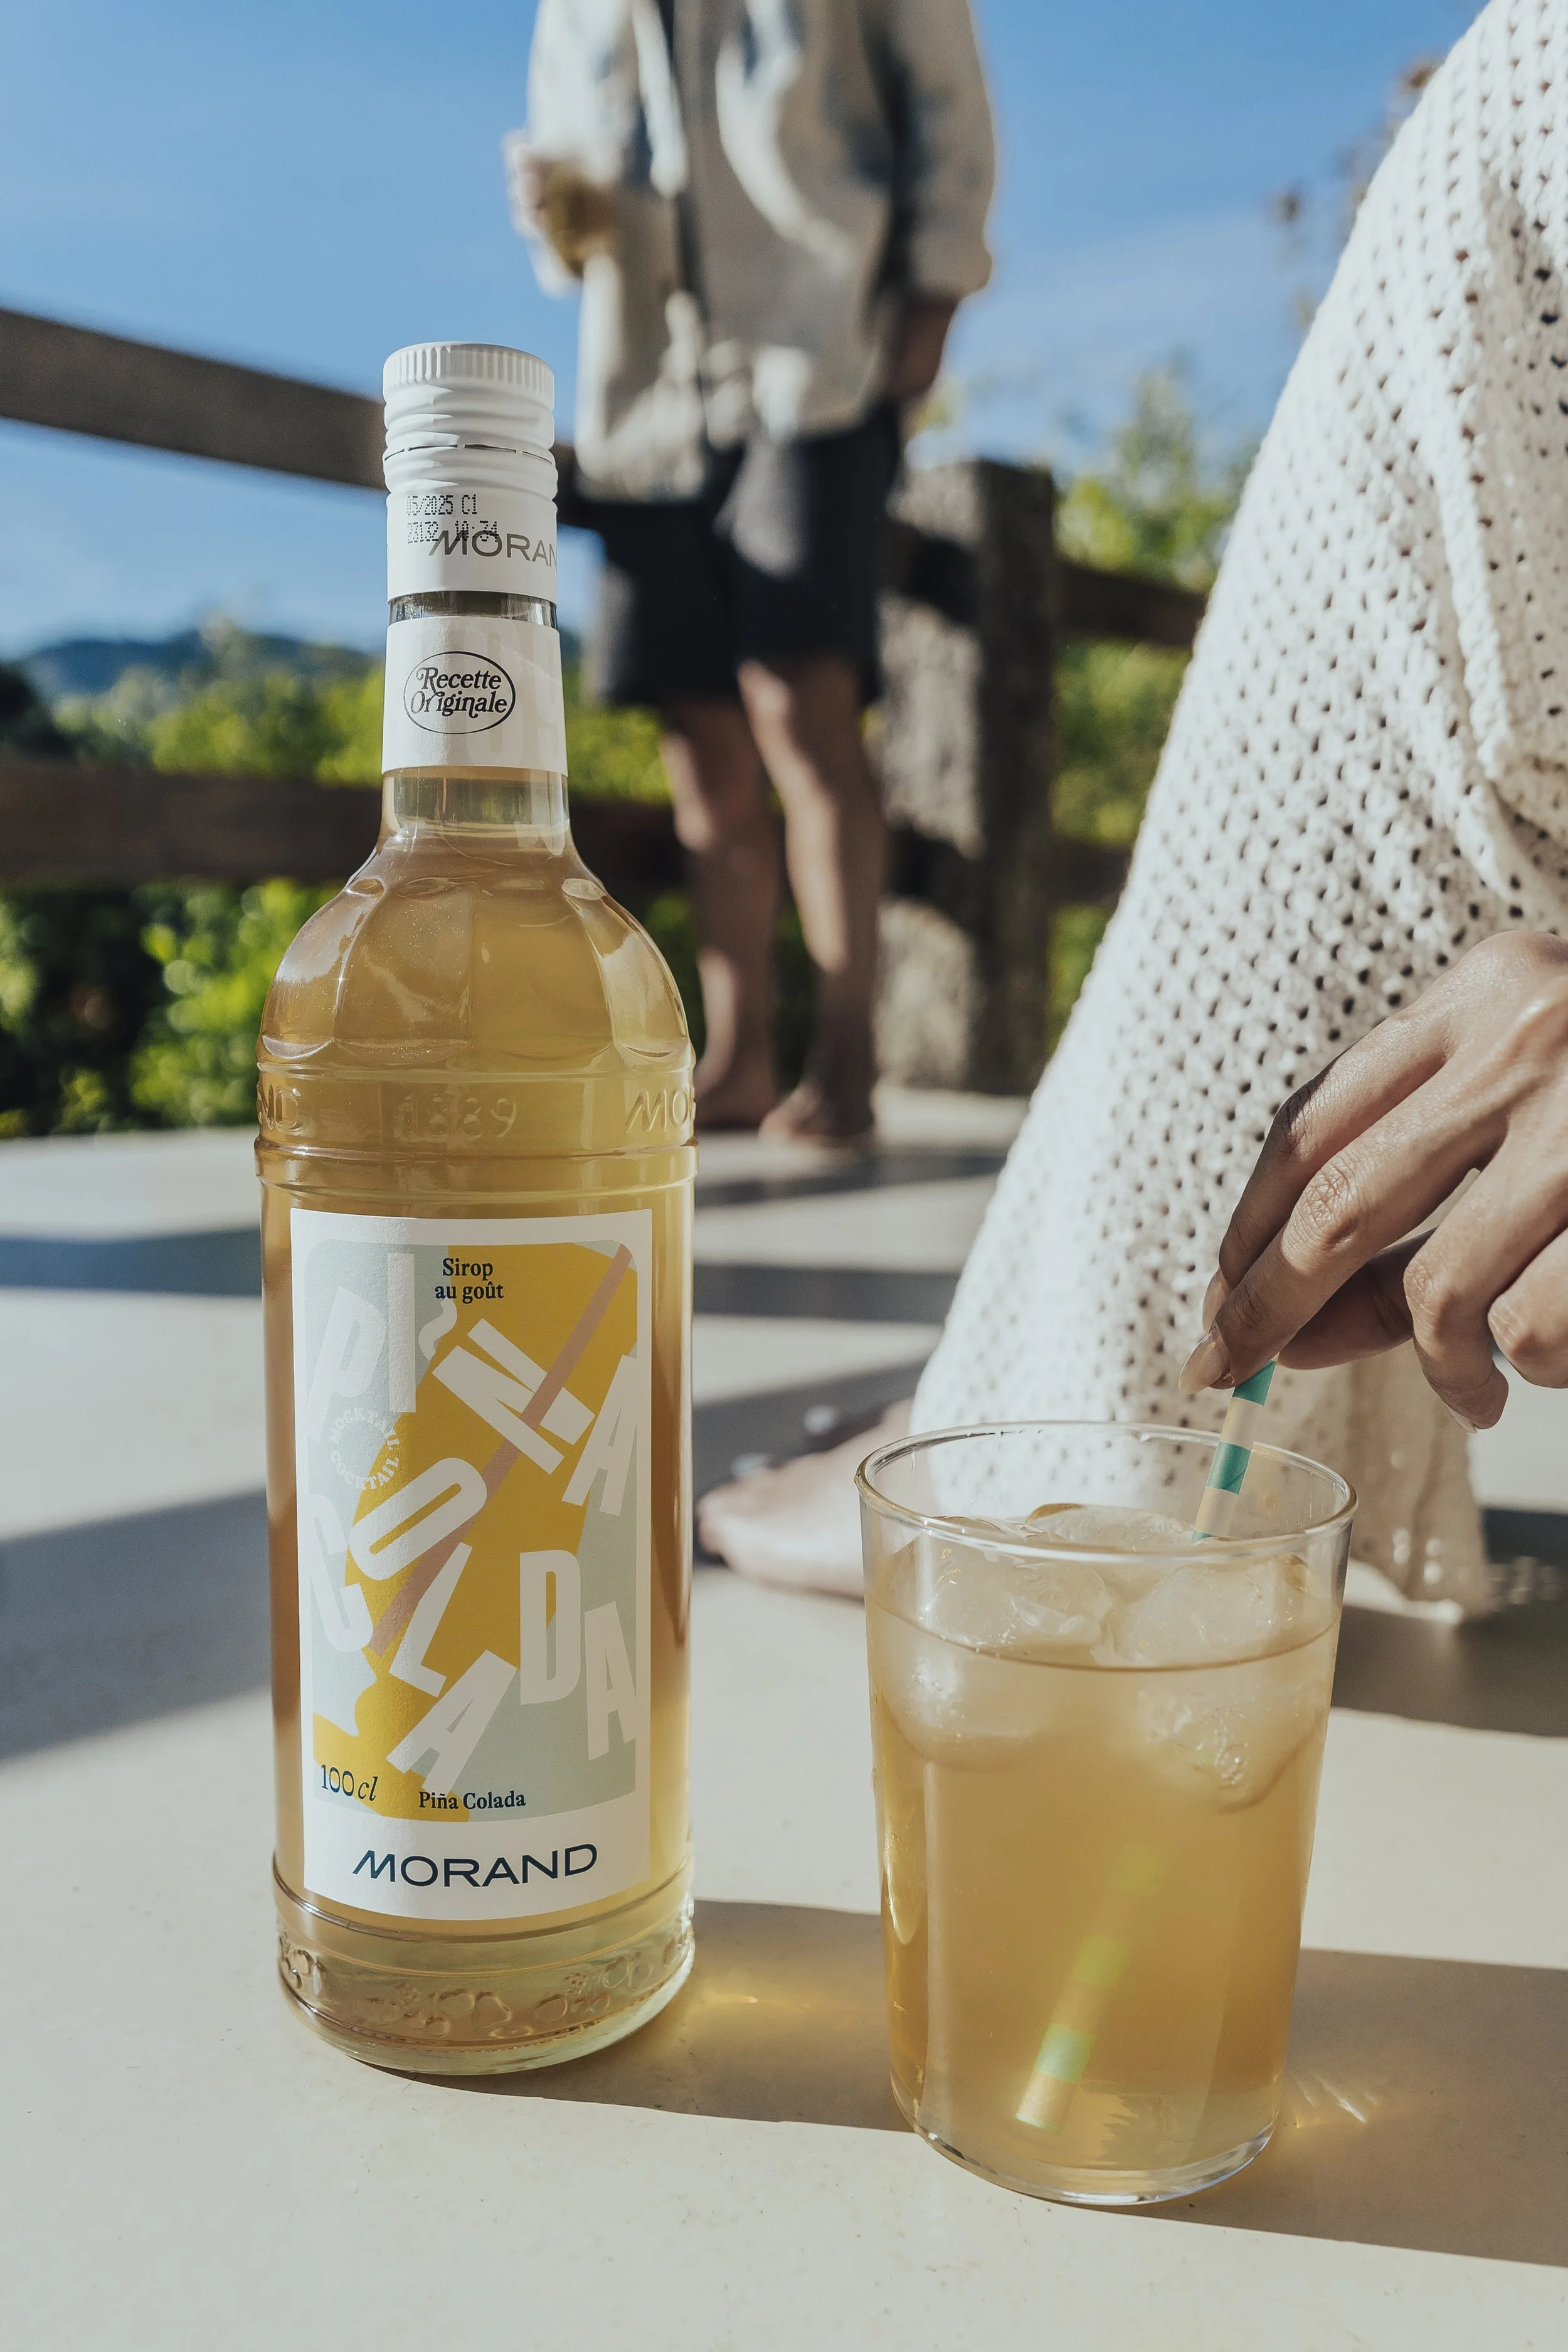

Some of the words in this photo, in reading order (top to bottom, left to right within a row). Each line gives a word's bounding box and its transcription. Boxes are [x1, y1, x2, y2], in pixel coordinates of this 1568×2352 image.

[406, 494, 453, 516] 05/2025
[462, 494, 478, 515] C1
[455, 520, 499, 543] 10:34
[416, 667, 502, 693] Recette
[410, 690, 507, 719] Originale
[400, 1095, 517, 1141] 1889
[442, 1258, 494, 1281] Sirop
[435, 1284, 457, 1300] au
[462, 1281, 505, 1305] goût
[330, 1450, 400, 1491] COCKTAIL
[320, 1764, 355, 1796] 100
[358, 1776, 379, 1801] cl
[418, 1791, 459, 1810] Piña
[462, 1789, 527, 1809] Colada
[352, 1843, 598, 1887] MORAND
